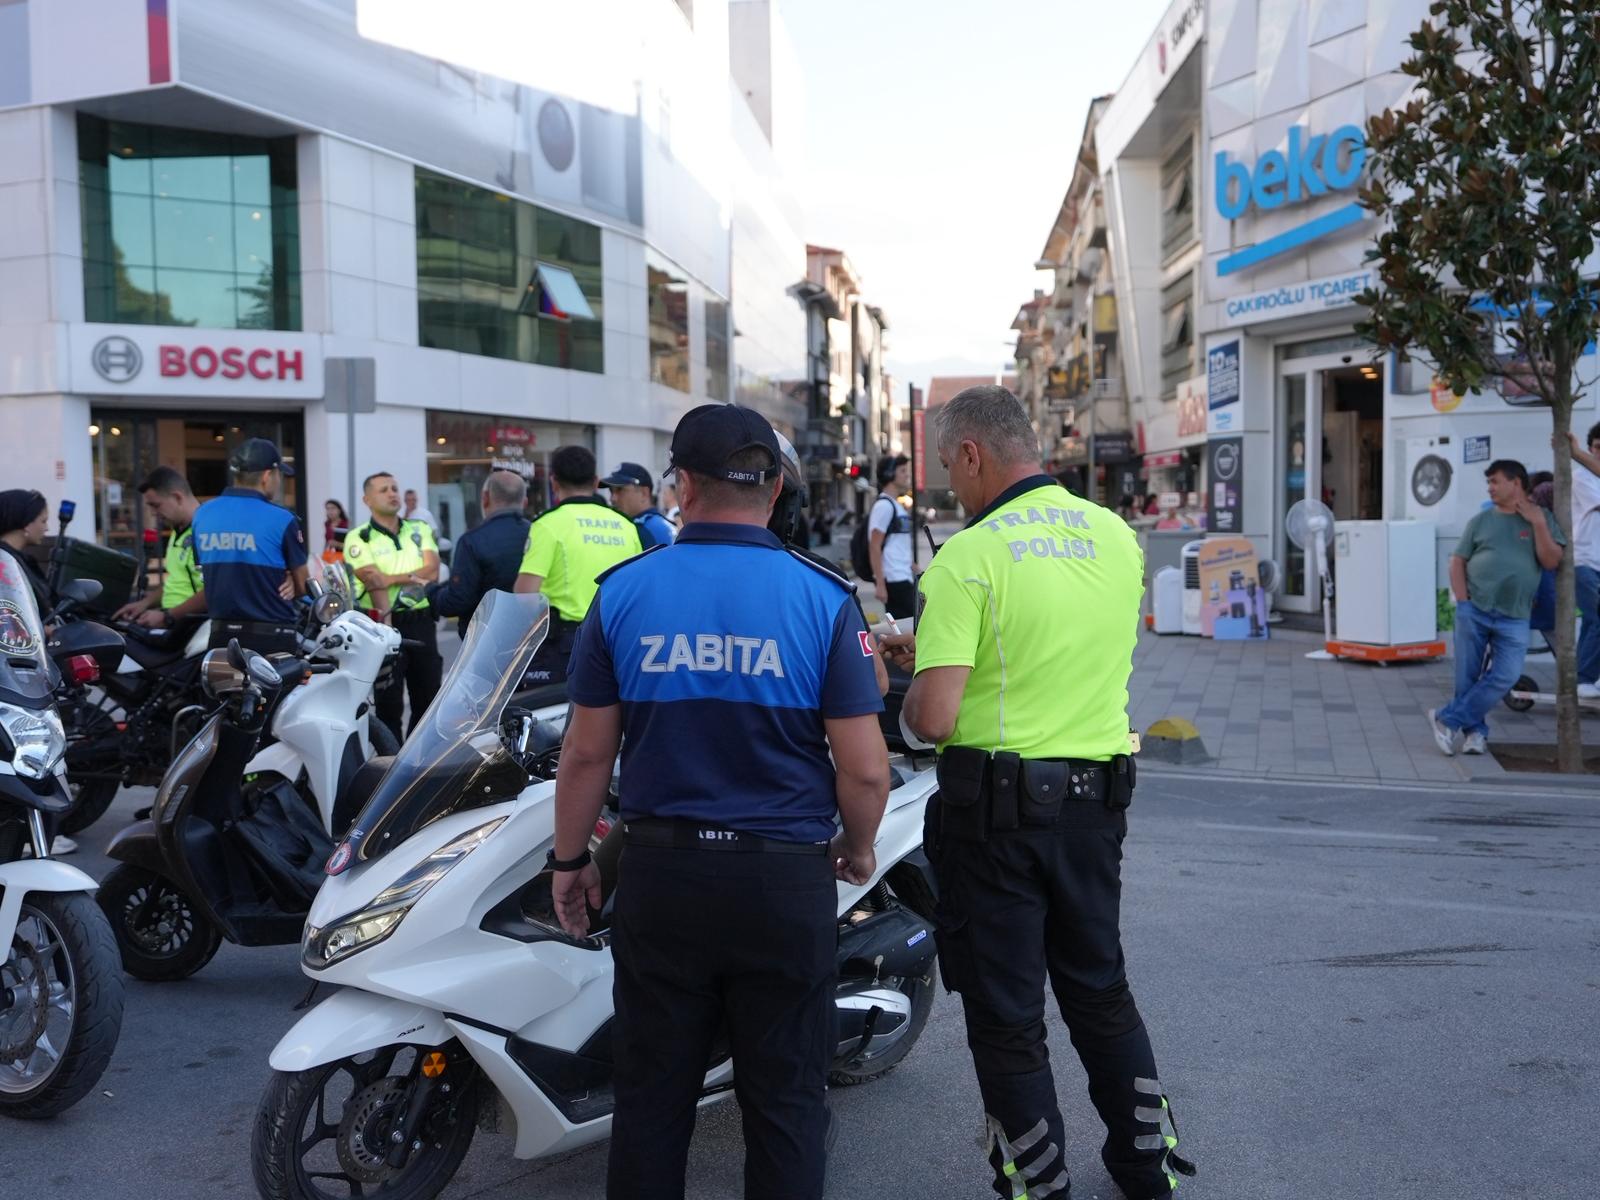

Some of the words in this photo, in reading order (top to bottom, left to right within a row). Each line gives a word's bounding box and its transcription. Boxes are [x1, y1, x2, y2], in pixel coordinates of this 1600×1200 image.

[1215, 124, 1366, 220] beko
[159, 345, 303, 381] BOSCH
[728, 471, 755, 481] ZABITA
[199, 531, 257, 552] ZABITA
[640, 633, 784, 678] ZABITA
